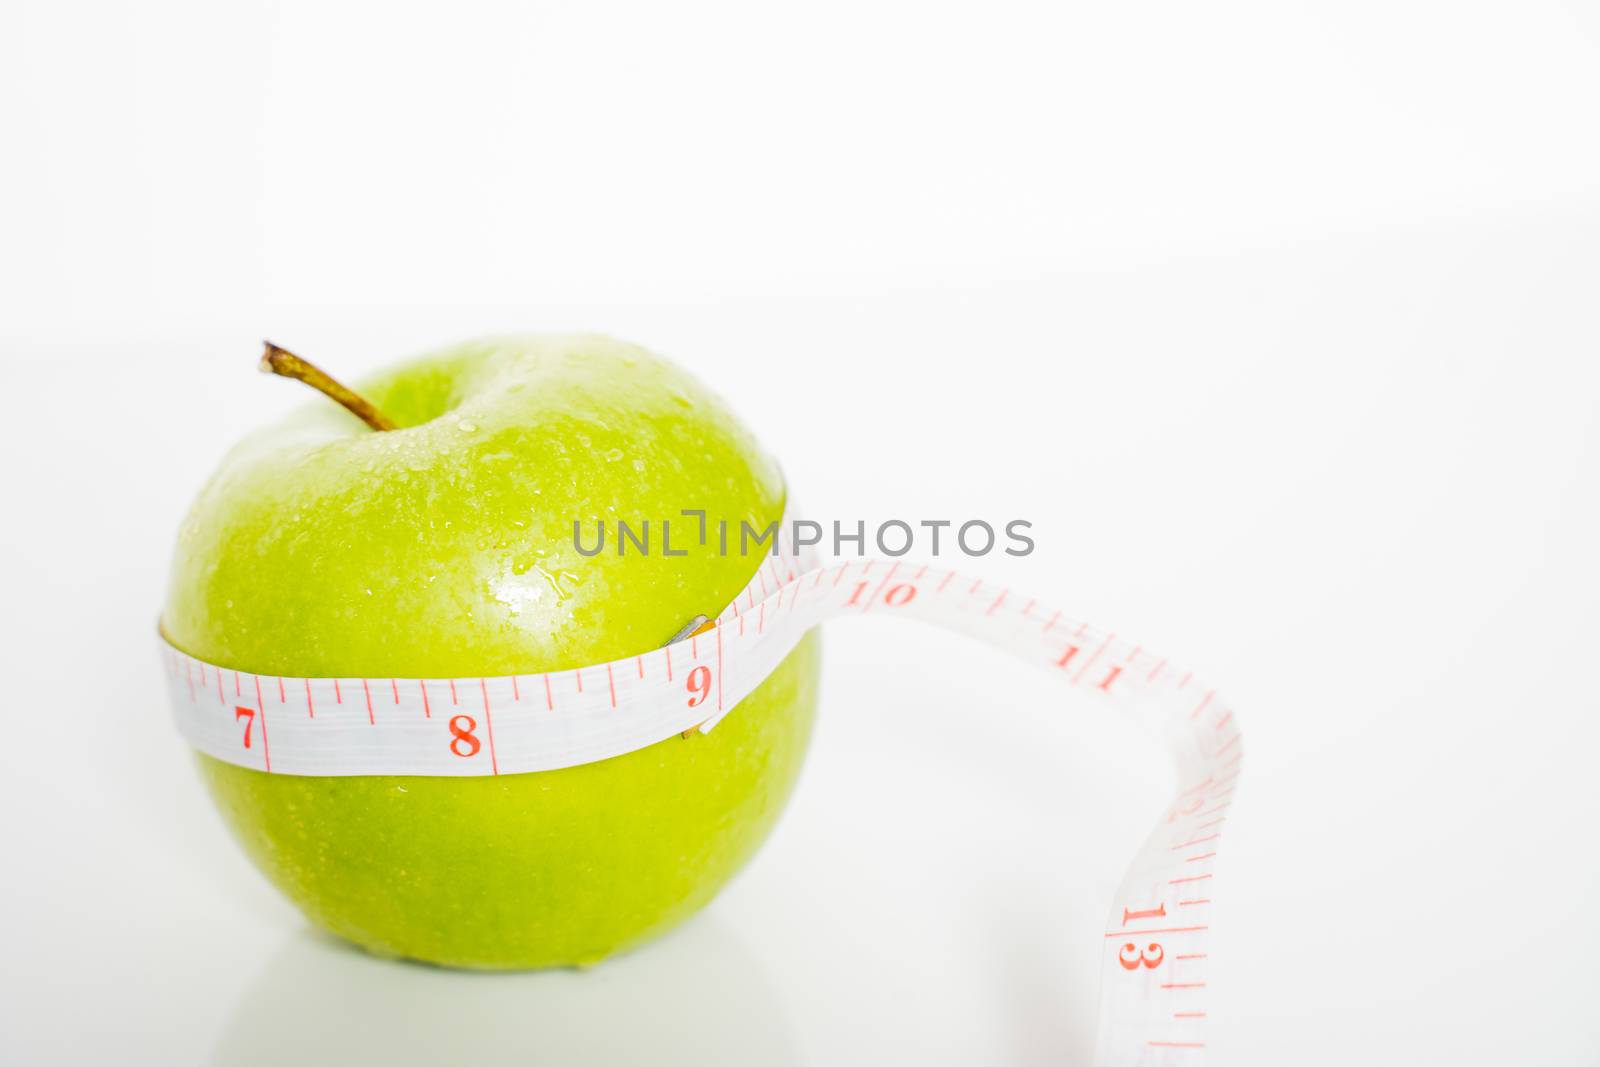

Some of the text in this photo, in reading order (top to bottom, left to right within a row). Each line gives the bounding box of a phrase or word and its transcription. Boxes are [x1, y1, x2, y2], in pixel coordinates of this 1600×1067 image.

[846, 580, 919, 608] 10
[684, 665, 713, 709] 9
[1053, 645, 1123, 693] 11
[234, 704, 258, 751] 7
[447, 714, 483, 759] 8
[1119, 902, 1168, 972] 13
